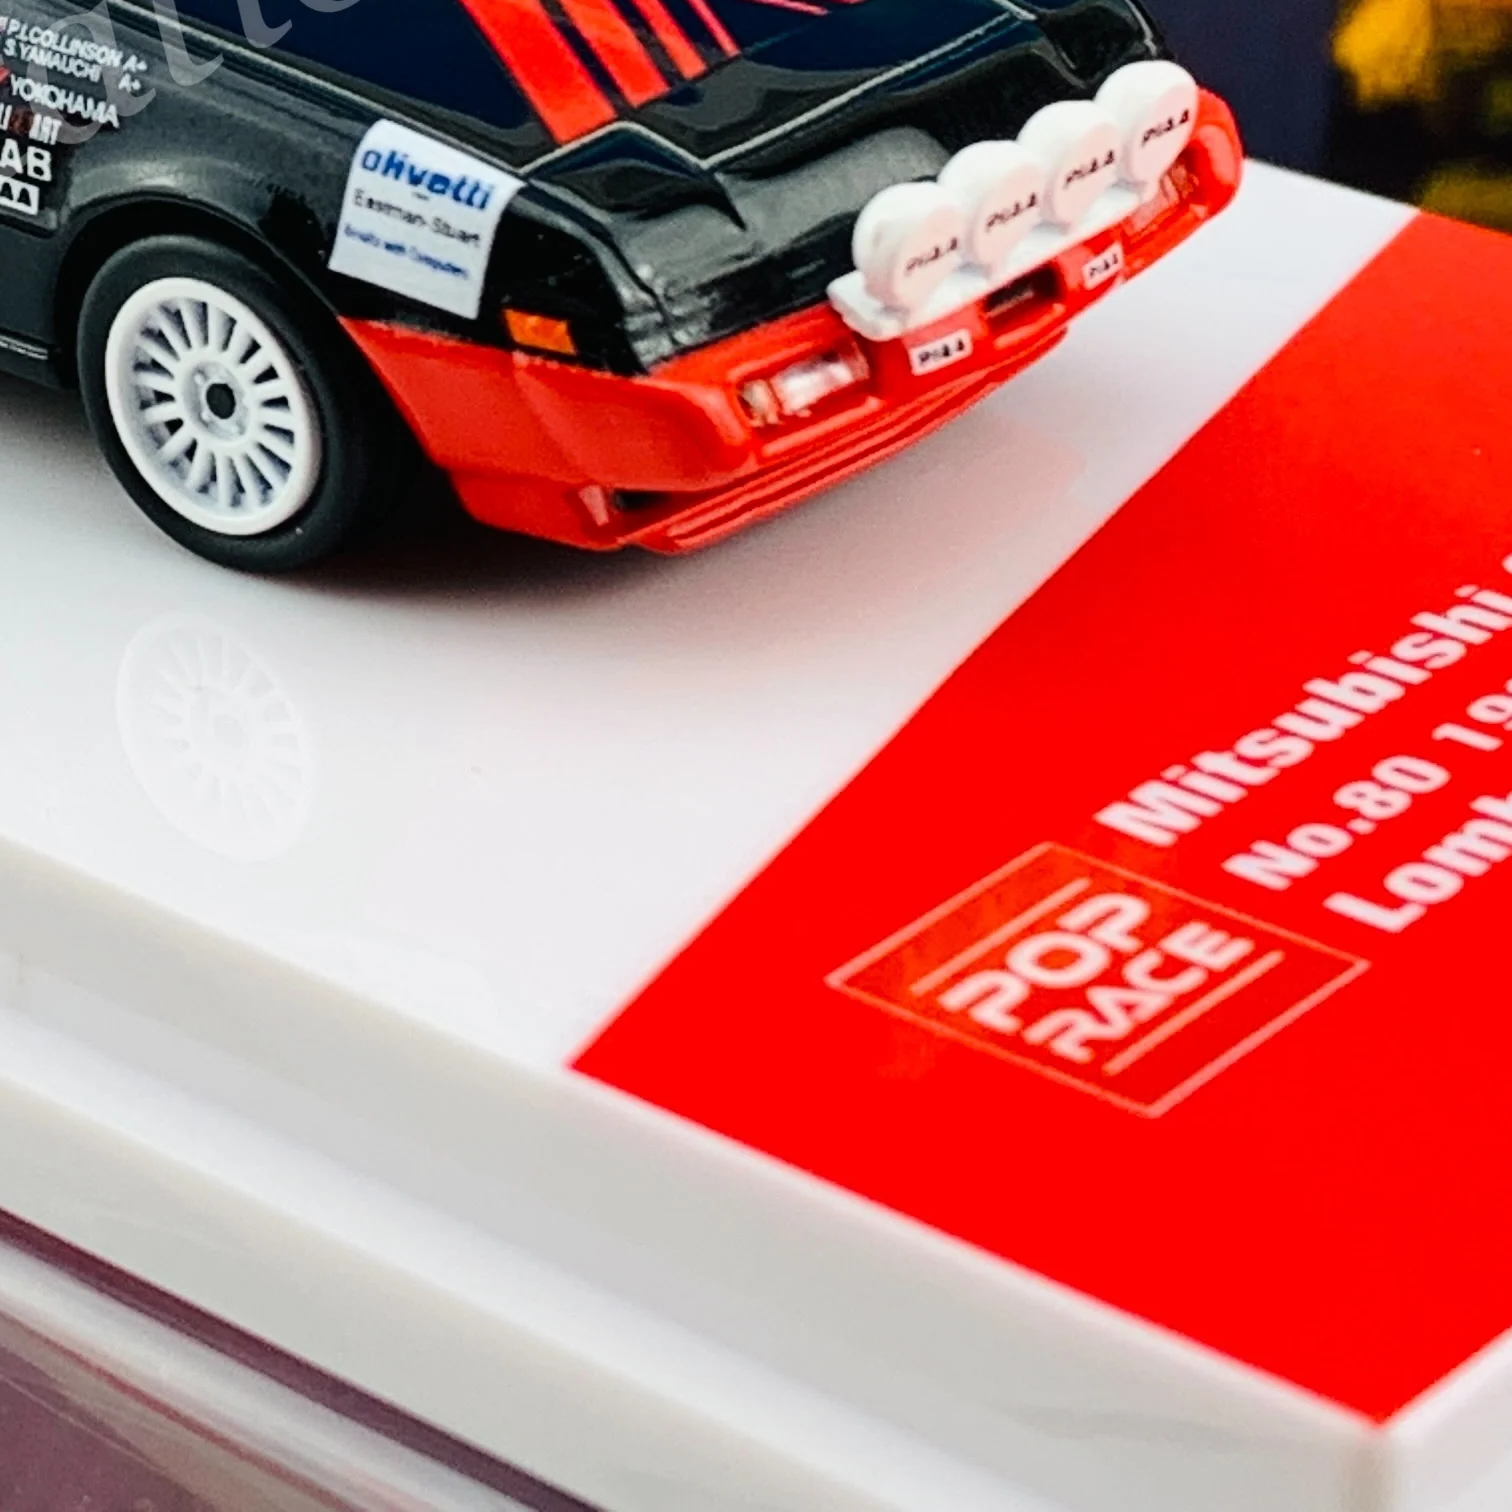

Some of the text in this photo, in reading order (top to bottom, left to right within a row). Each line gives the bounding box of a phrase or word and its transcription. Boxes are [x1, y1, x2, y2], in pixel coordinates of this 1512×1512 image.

[10, 73, 120, 129] YOKOHAMA
[1141, 109, 1190, 147] PIAA
[1064, 149, 1115, 190] PIAA
[986, 192, 1038, 233] PIAA
[903, 236, 959, 277] PIAA
[1088, 254, 1120, 278] PIAA
[917, 337, 966, 368] PIAA
[1093, 584, 1512, 848] Mitsubishi
[1221, 754, 1453, 891] No.80
[937, 891, 1151, 1034] POP
[1023, 920, 1255, 1064] RACE
